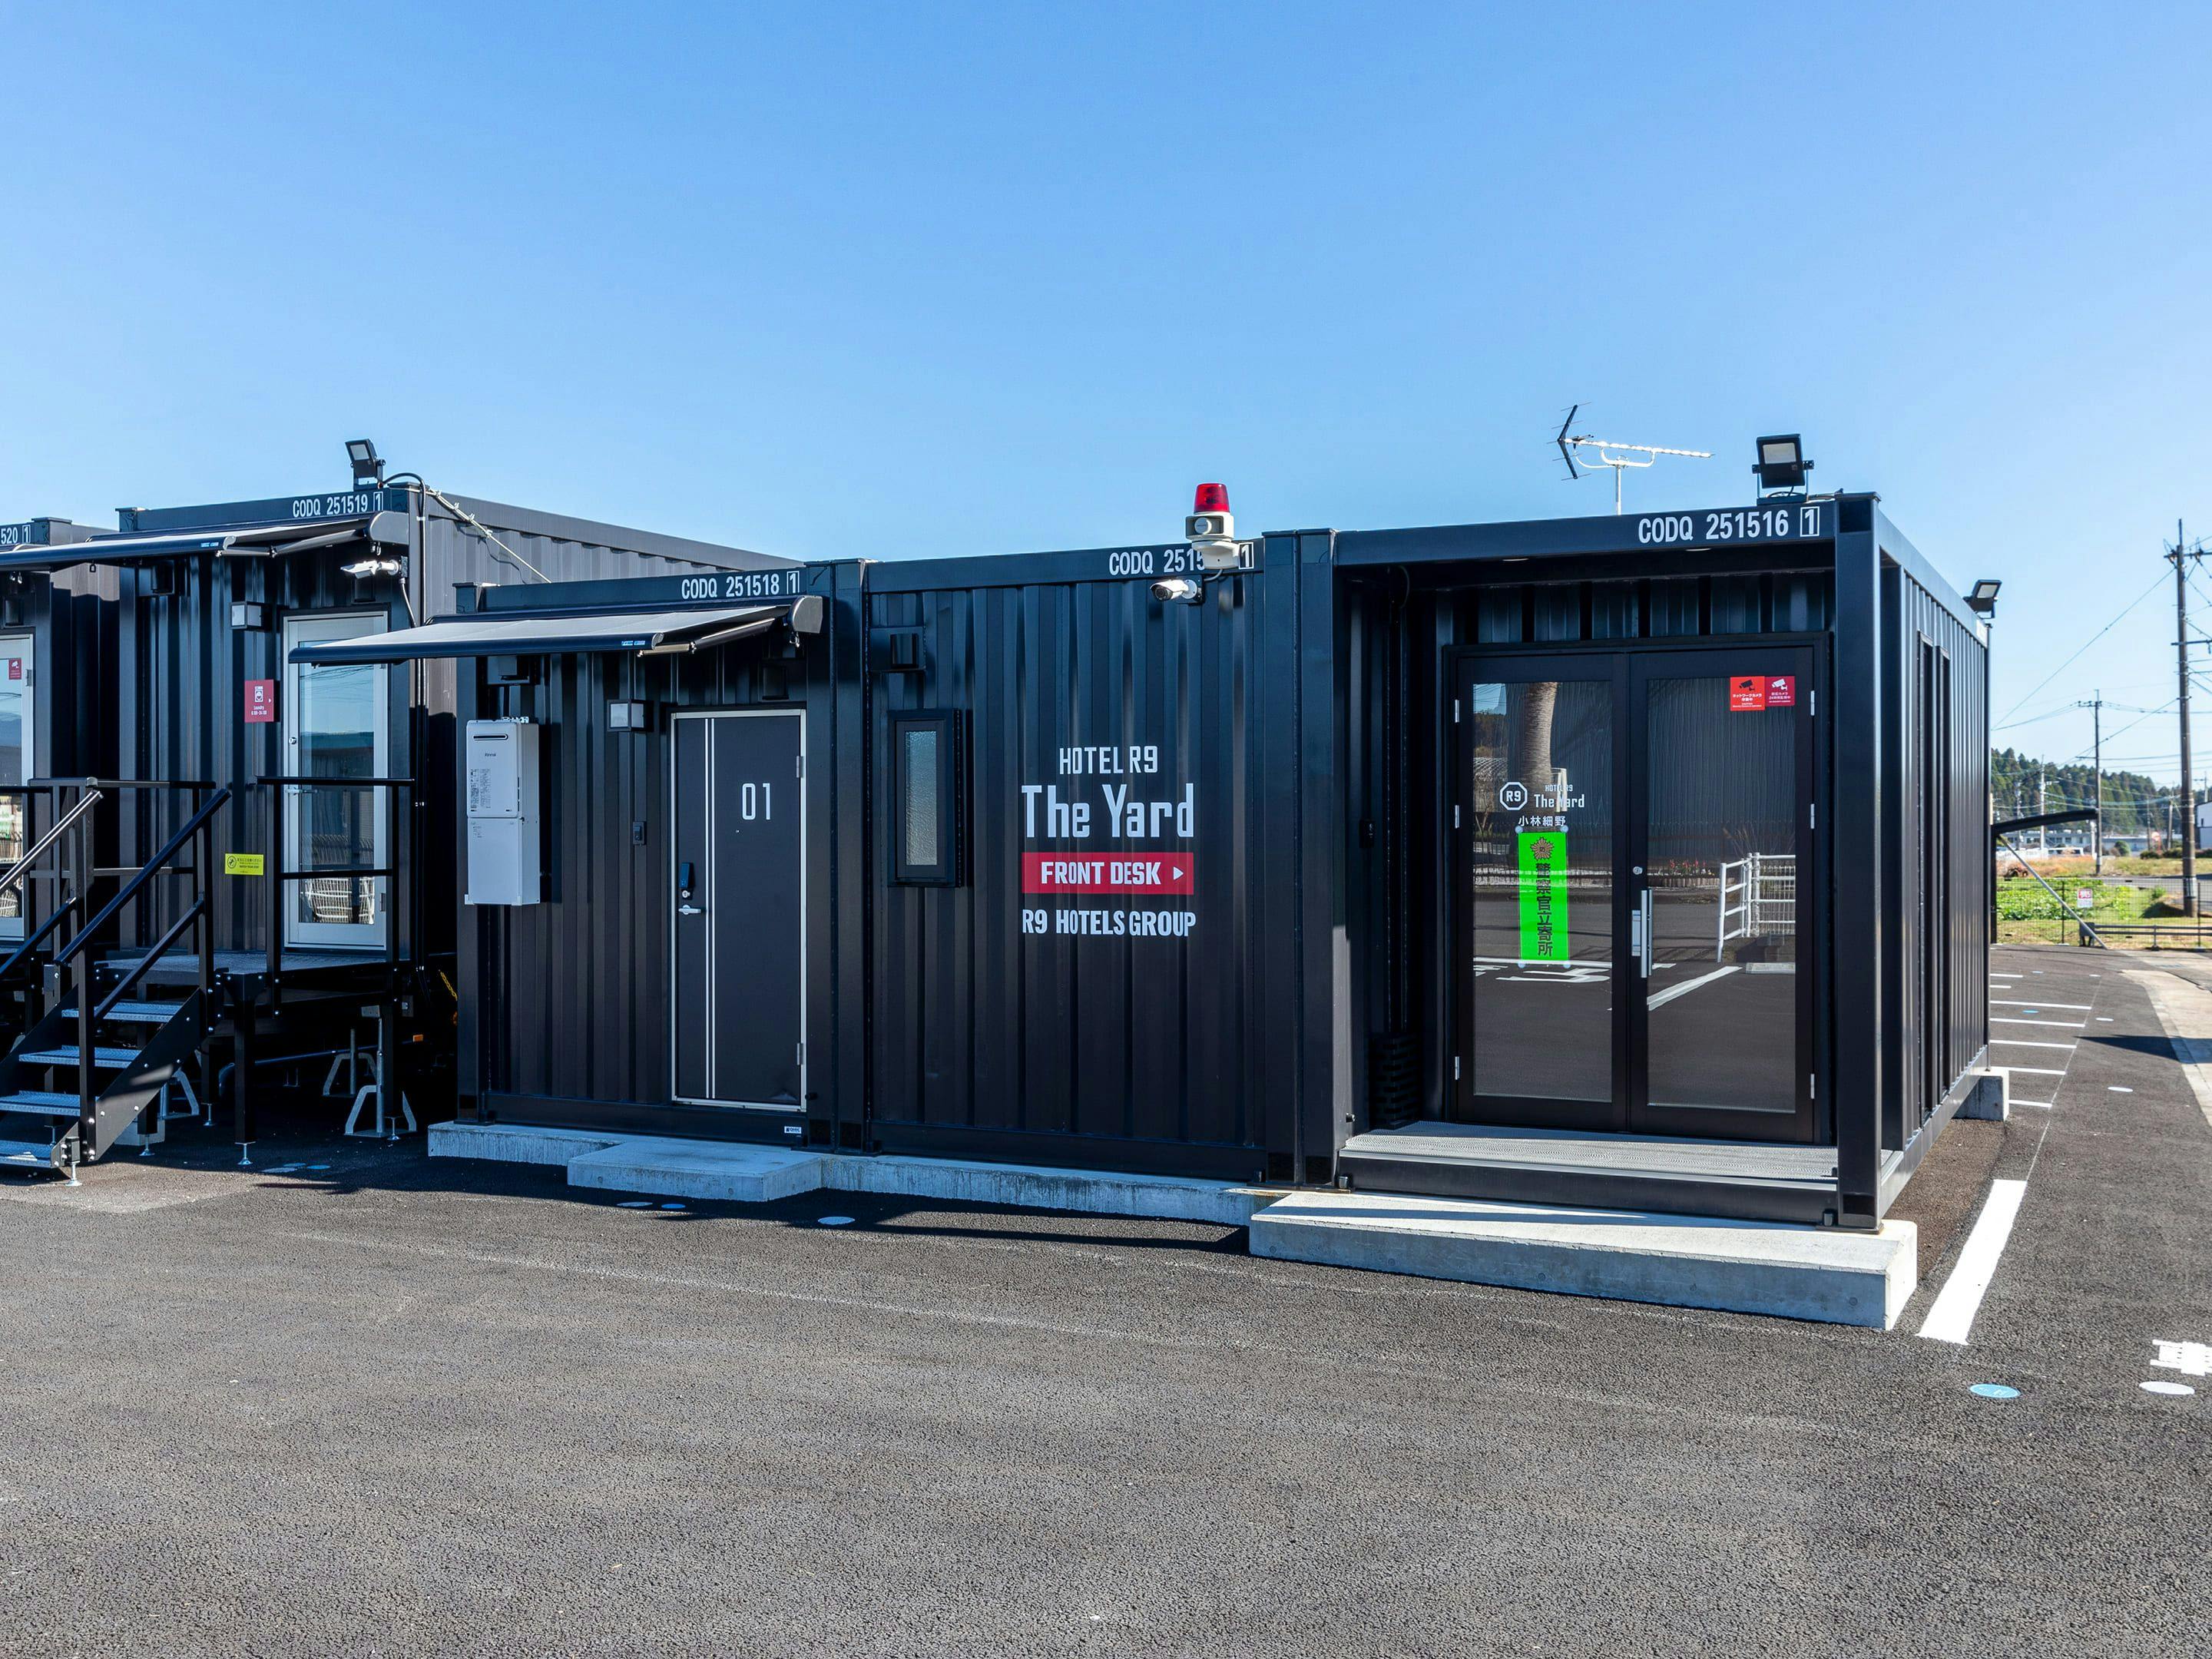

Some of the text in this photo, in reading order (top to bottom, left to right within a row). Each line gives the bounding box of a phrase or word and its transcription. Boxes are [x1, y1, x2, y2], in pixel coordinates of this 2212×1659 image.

[293, 492, 382, 518] CODQ 251519 1
[1638, 508, 1816, 544] CODQ 251516 1
[1109, 544, 1251, 575] CODQ 2515 1
[681, 572, 798, 599] CODQ 251518 1
[1059, 745, 1158, 775] HOTEL R9
[742, 783, 770, 820] 01
[1506, 790, 1522, 802] R9
[1534, 793, 1555, 808] The
[1022, 783, 1194, 838] The Yard
[1518, 815, 1566, 826] 小林細野
[1041, 861, 1161, 885] FRONT DESK
[1022, 909, 1196, 937] R9 HOTELS GROUP
